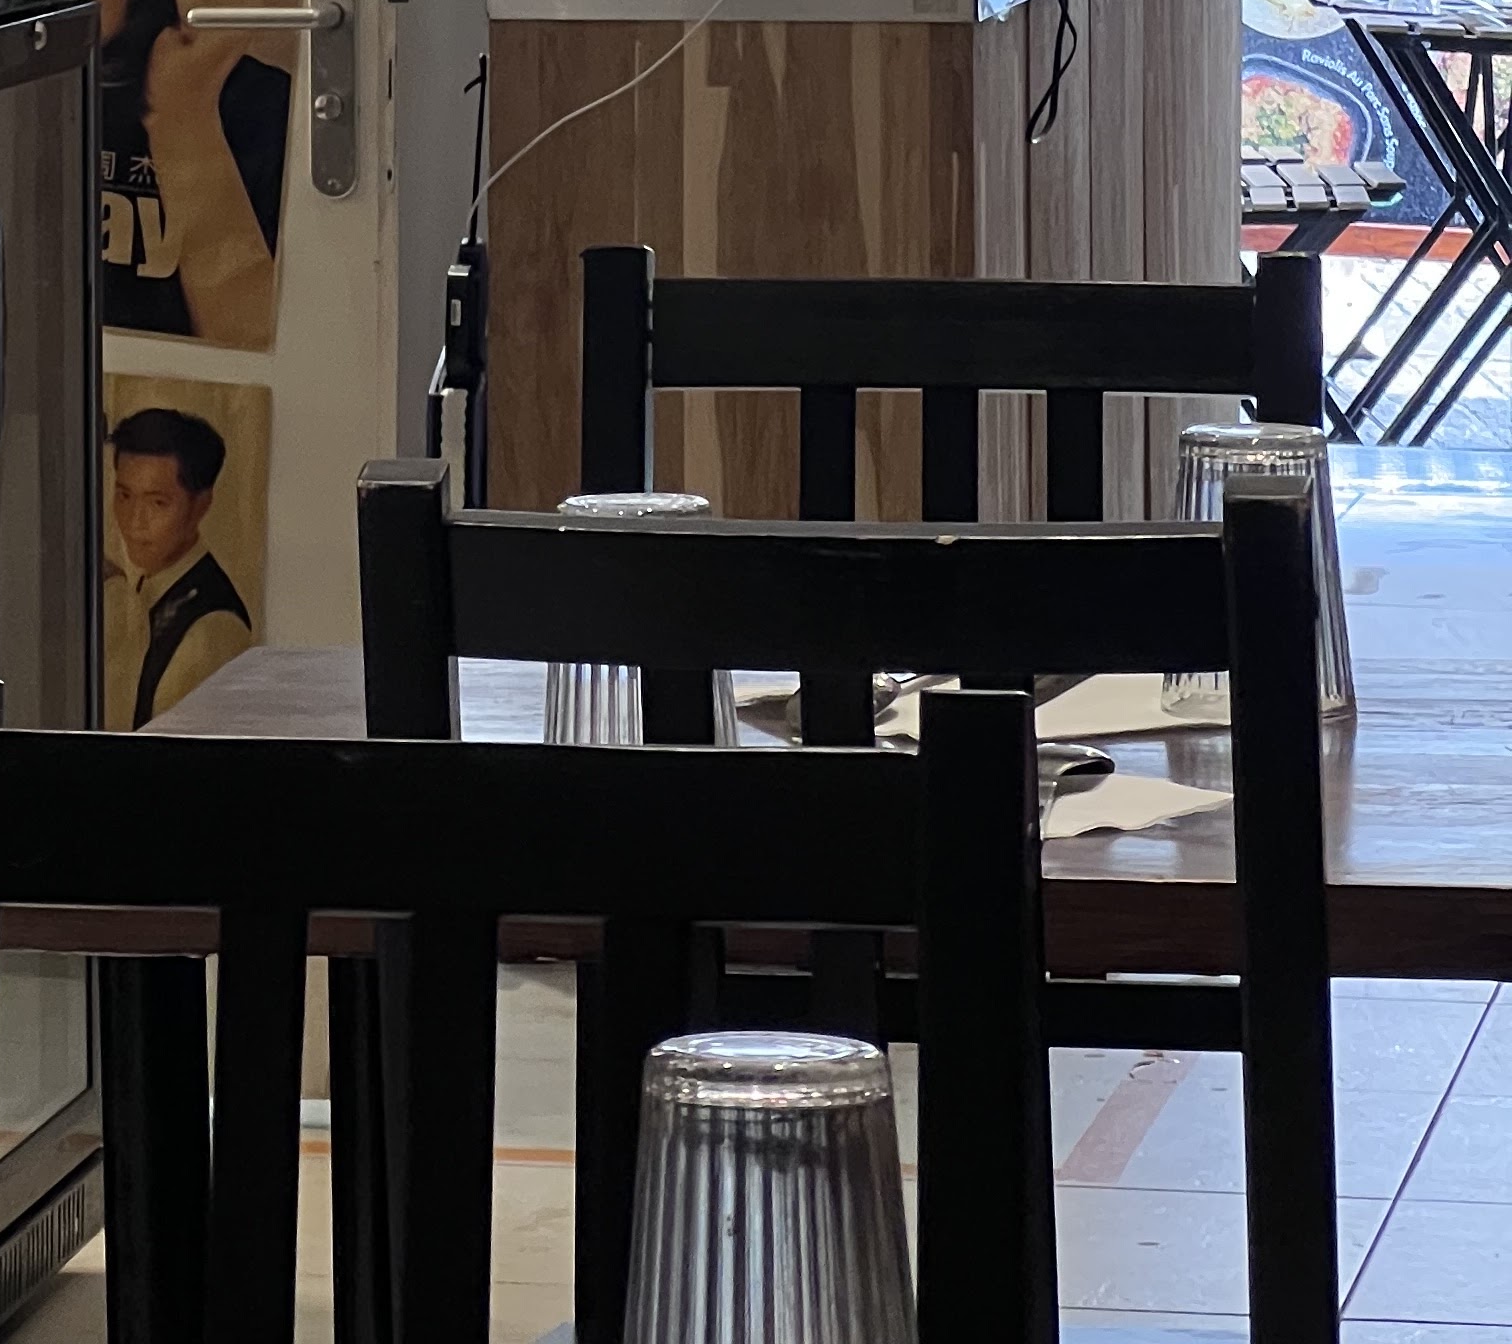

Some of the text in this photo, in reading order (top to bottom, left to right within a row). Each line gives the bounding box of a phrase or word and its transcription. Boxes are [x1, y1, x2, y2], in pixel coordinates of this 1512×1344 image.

[1301, 48, 1348, 77] Raviolis
[1346, 70, 1364, 88] Au
[1384, 137, 1400, 172] Soup
[101, 190, 180, 279] ay
